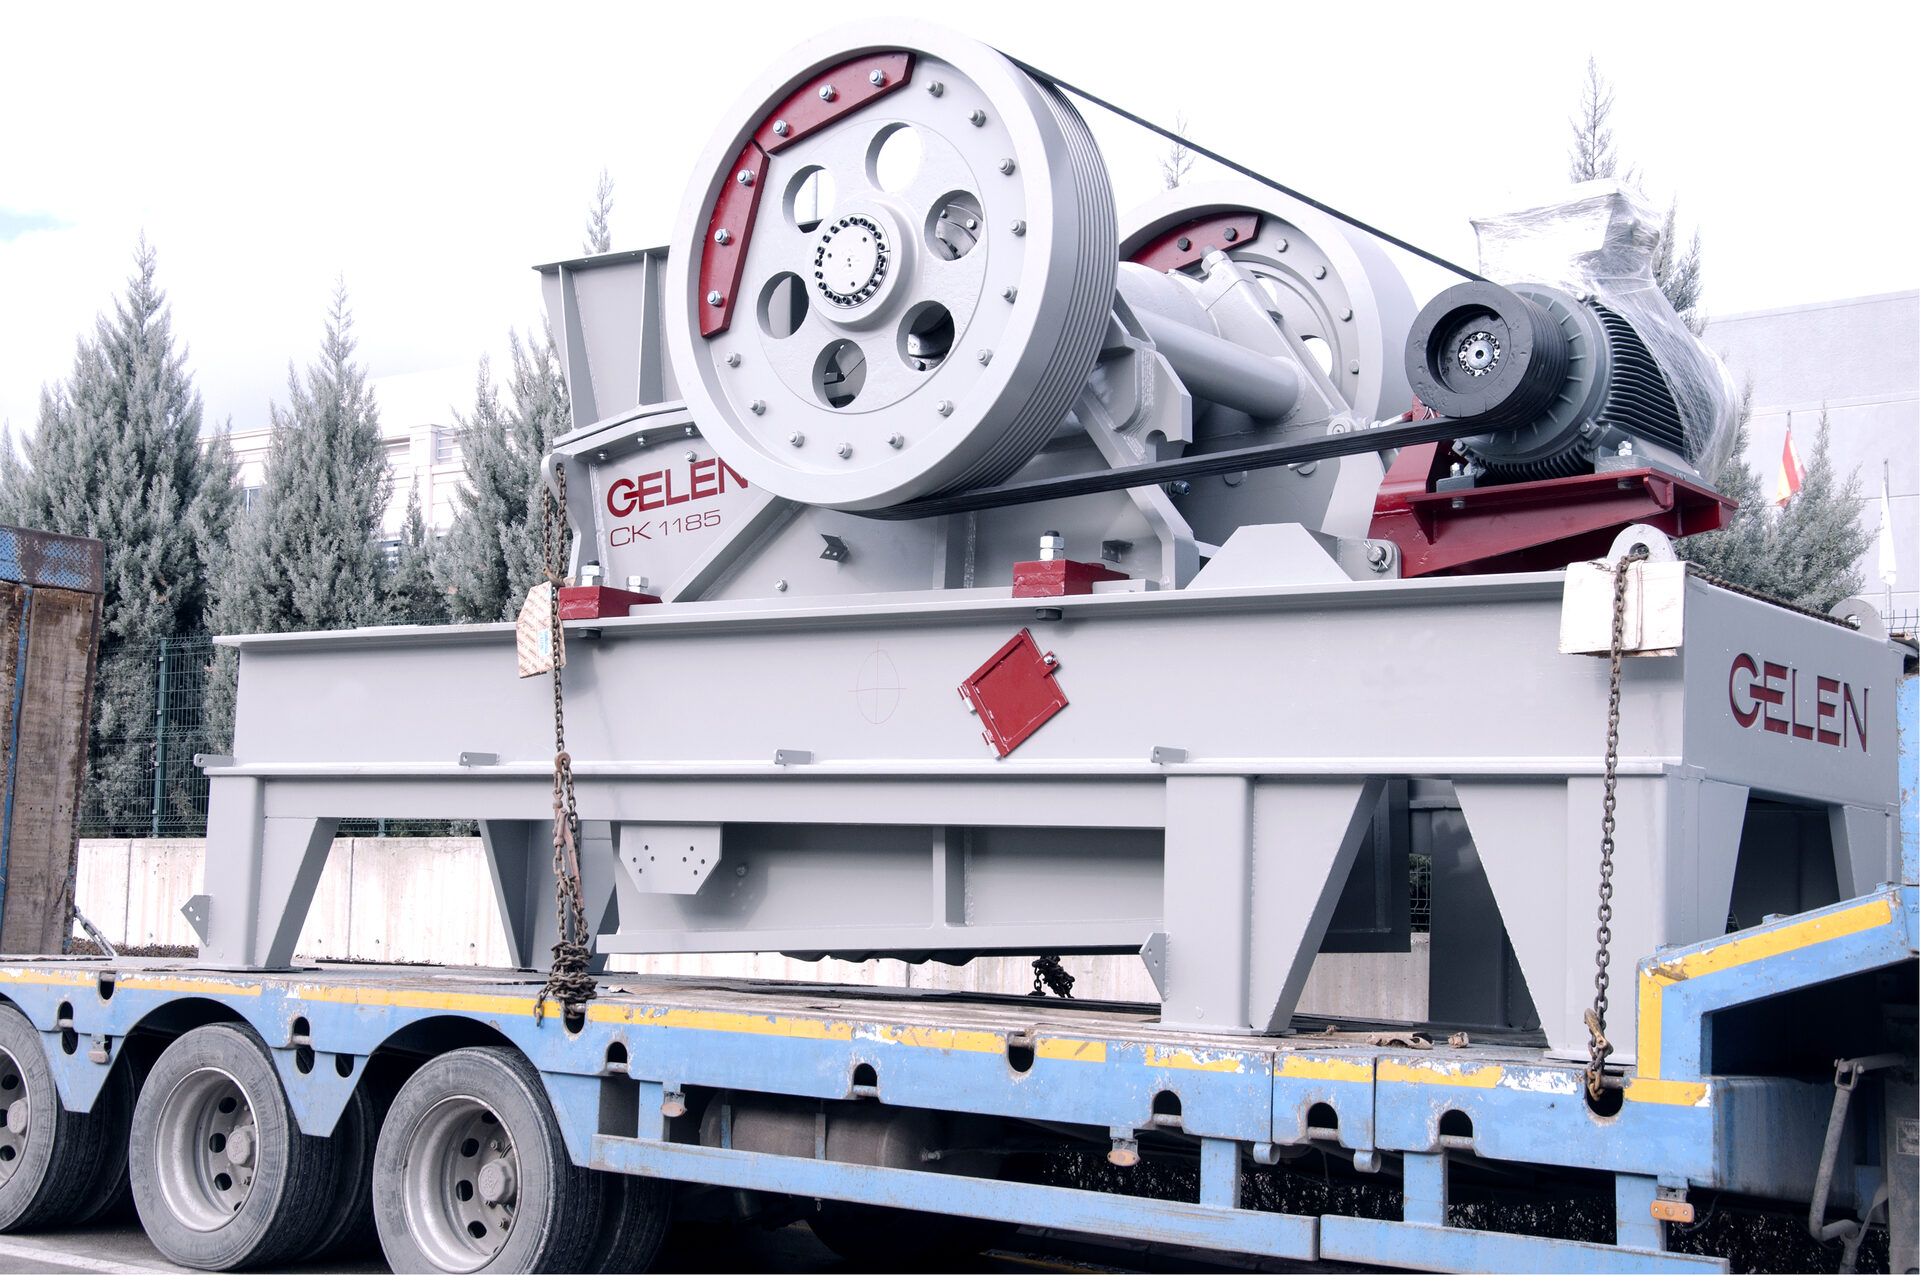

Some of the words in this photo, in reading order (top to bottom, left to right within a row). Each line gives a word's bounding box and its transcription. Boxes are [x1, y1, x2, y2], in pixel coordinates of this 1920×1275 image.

[607, 457, 748, 518] GELEN
[610, 521, 652, 547] CK
[659, 509, 721, 537] 1185
[1729, 653, 1868, 752] GELEN
